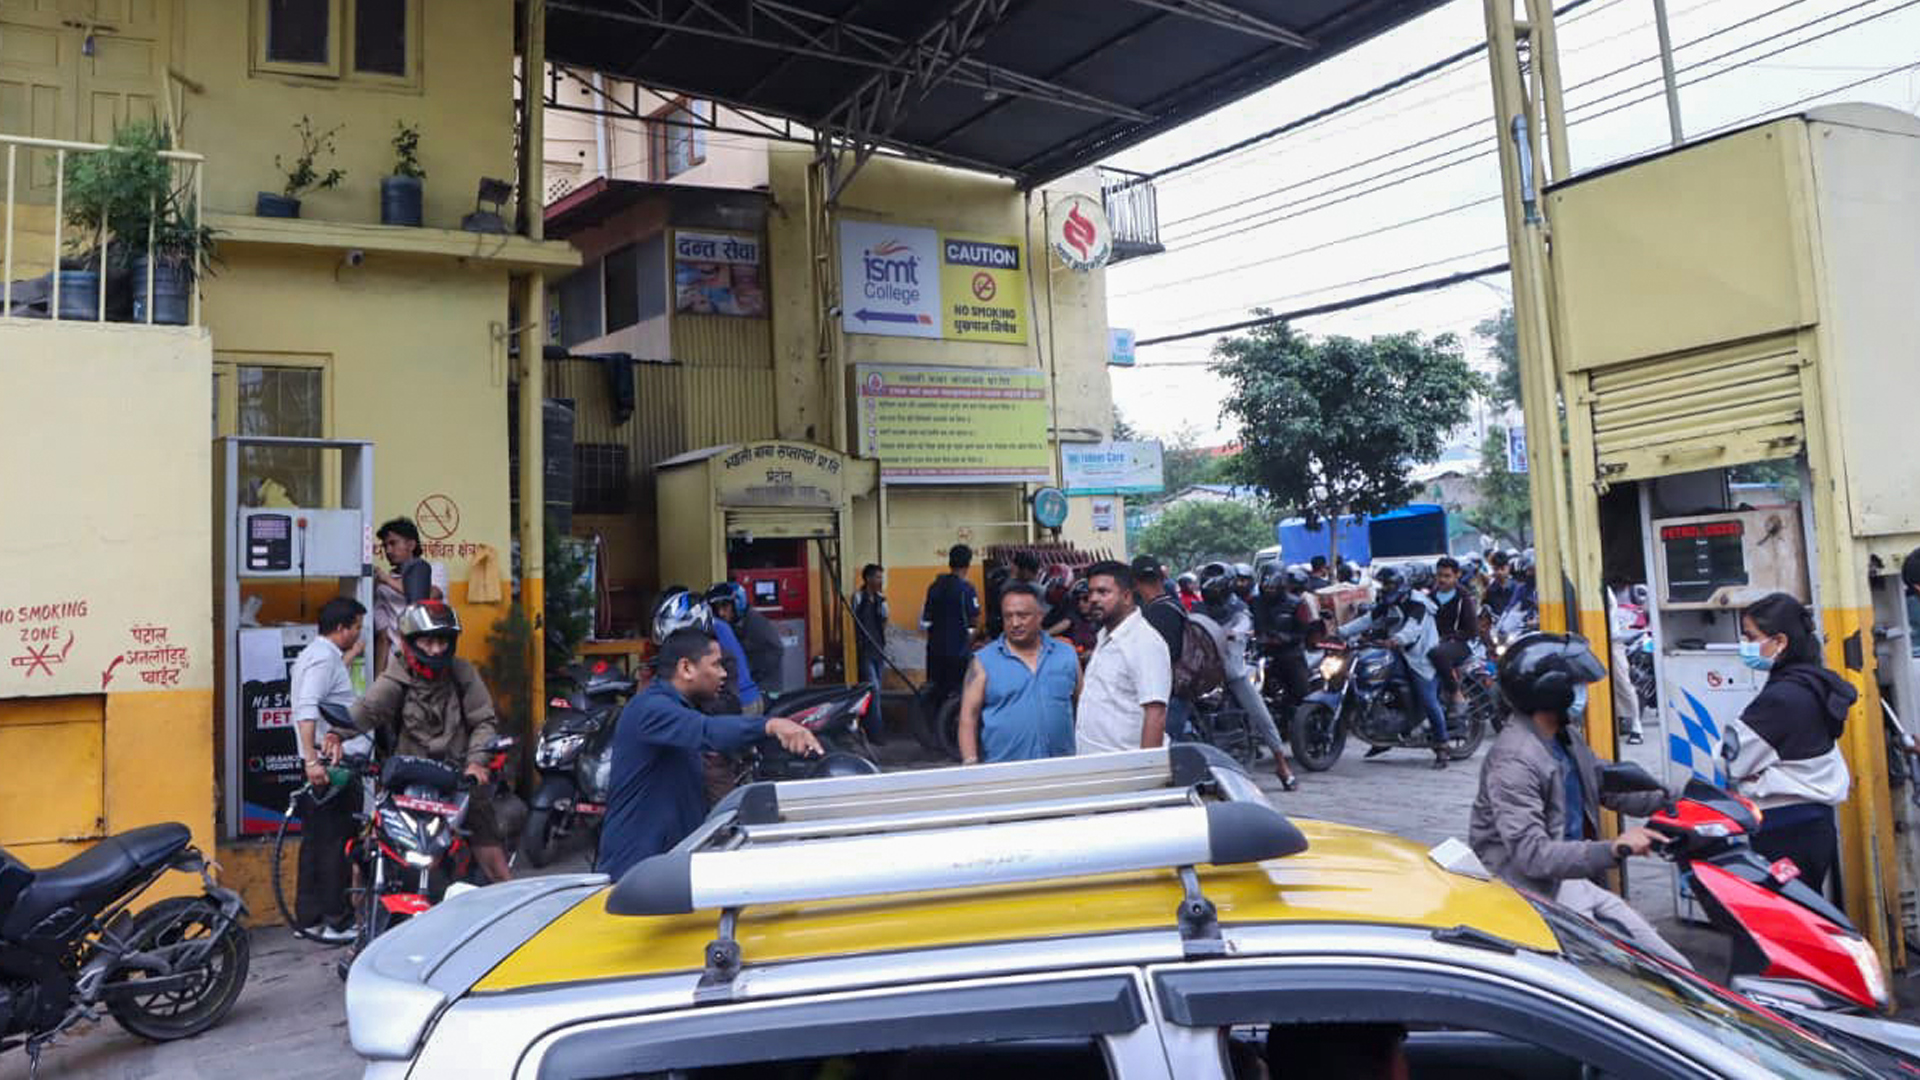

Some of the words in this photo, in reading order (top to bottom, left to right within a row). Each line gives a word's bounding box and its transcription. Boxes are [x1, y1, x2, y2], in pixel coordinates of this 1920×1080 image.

[947, 244, 1016, 265] CAUTION
[863, 249, 919, 285] ismt
[864, 281, 920, 305] College
[954, 304, 970, 316] NO
[971, 306, 1016, 320] SMOKING
[18, 601, 88, 623] SMOKING
[20, 626, 60, 642] ZONE
[262, 711, 292, 725] PET
